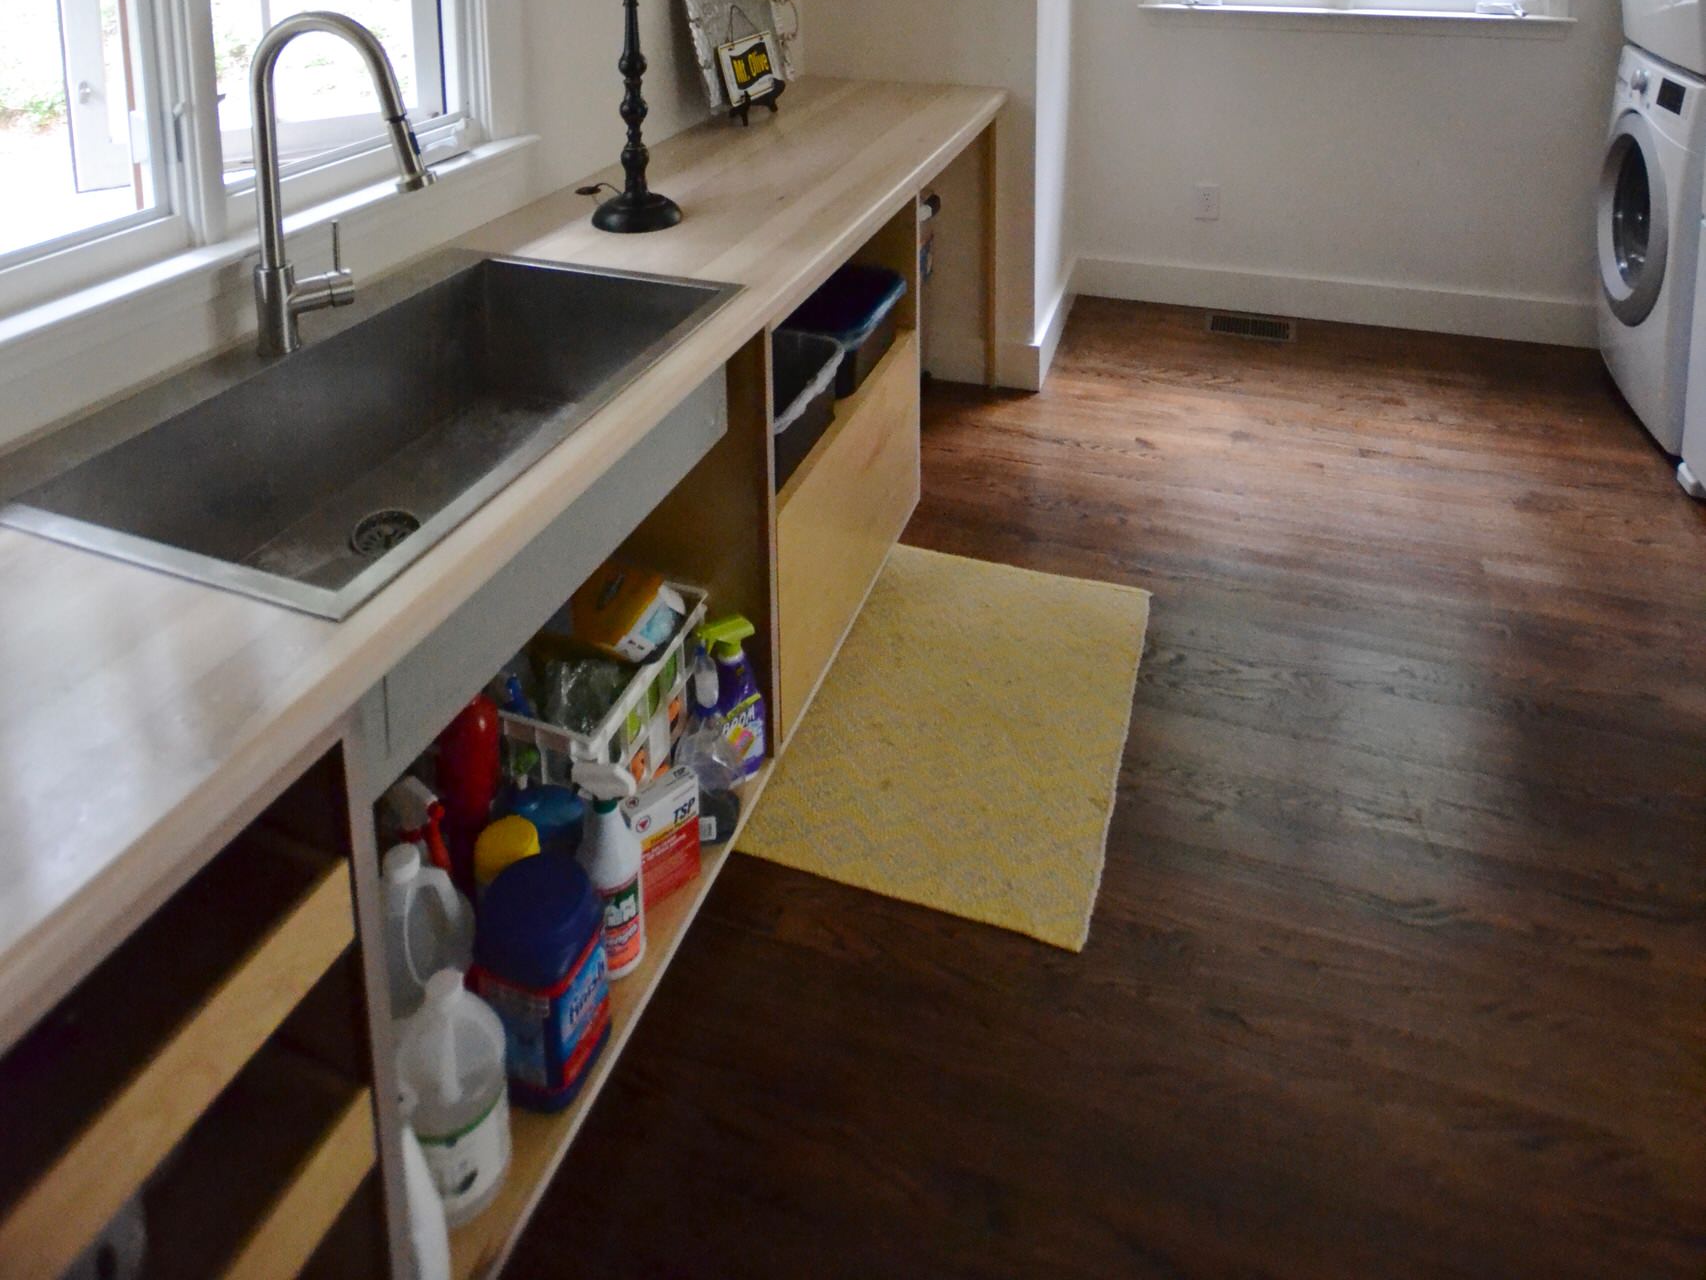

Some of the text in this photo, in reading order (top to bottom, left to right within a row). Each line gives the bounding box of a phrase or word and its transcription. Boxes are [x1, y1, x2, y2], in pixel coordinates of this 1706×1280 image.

[732, 51, 769, 84] Mt. Olive
[673, 797, 696, 825] TSP
